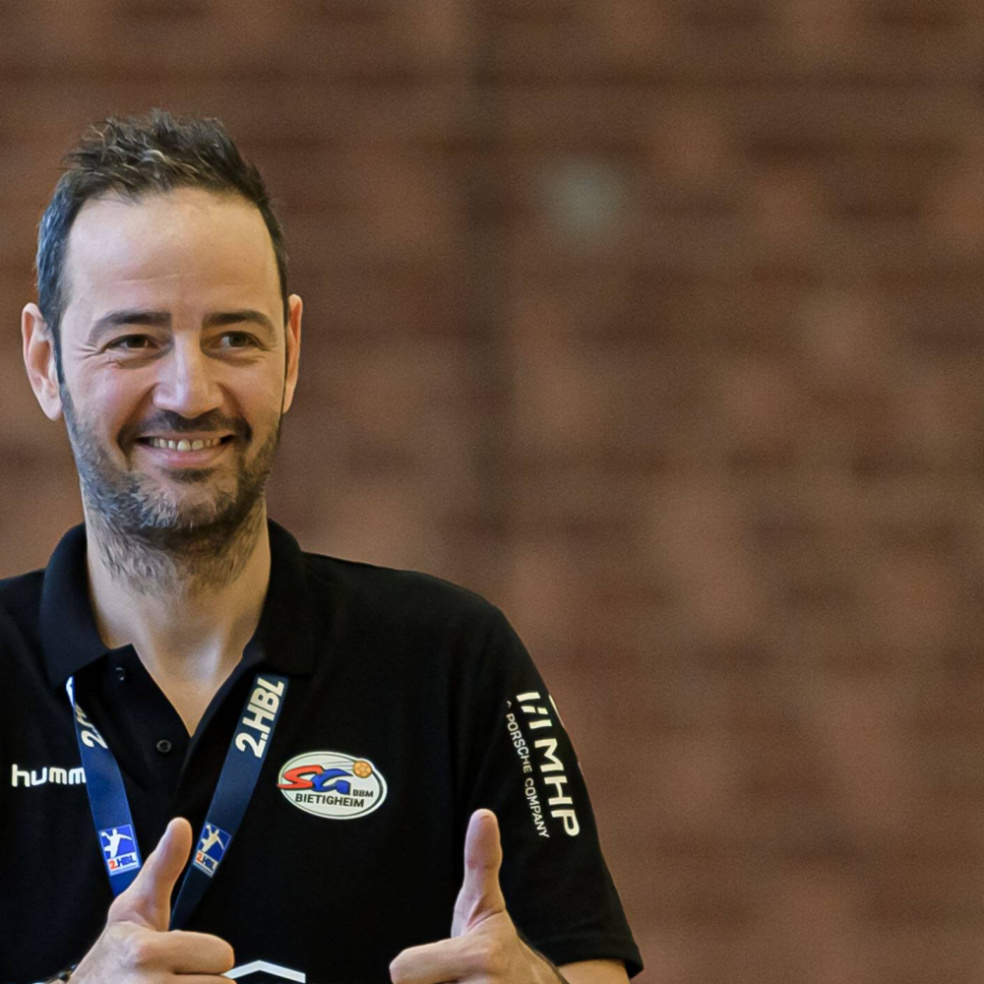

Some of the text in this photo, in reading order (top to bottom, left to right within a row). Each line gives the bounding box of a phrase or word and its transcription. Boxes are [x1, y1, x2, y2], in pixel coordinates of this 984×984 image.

[235, 677, 285, 758] 2.HBL
[11, 763, 87, 788] humm
[295, 793, 365, 808] BIETIGHEIM
[506, 713, 533, 773] PORSCHE
[524, 778, 550, 838] COMPANY
[534, 738, 580, 837] MHP
